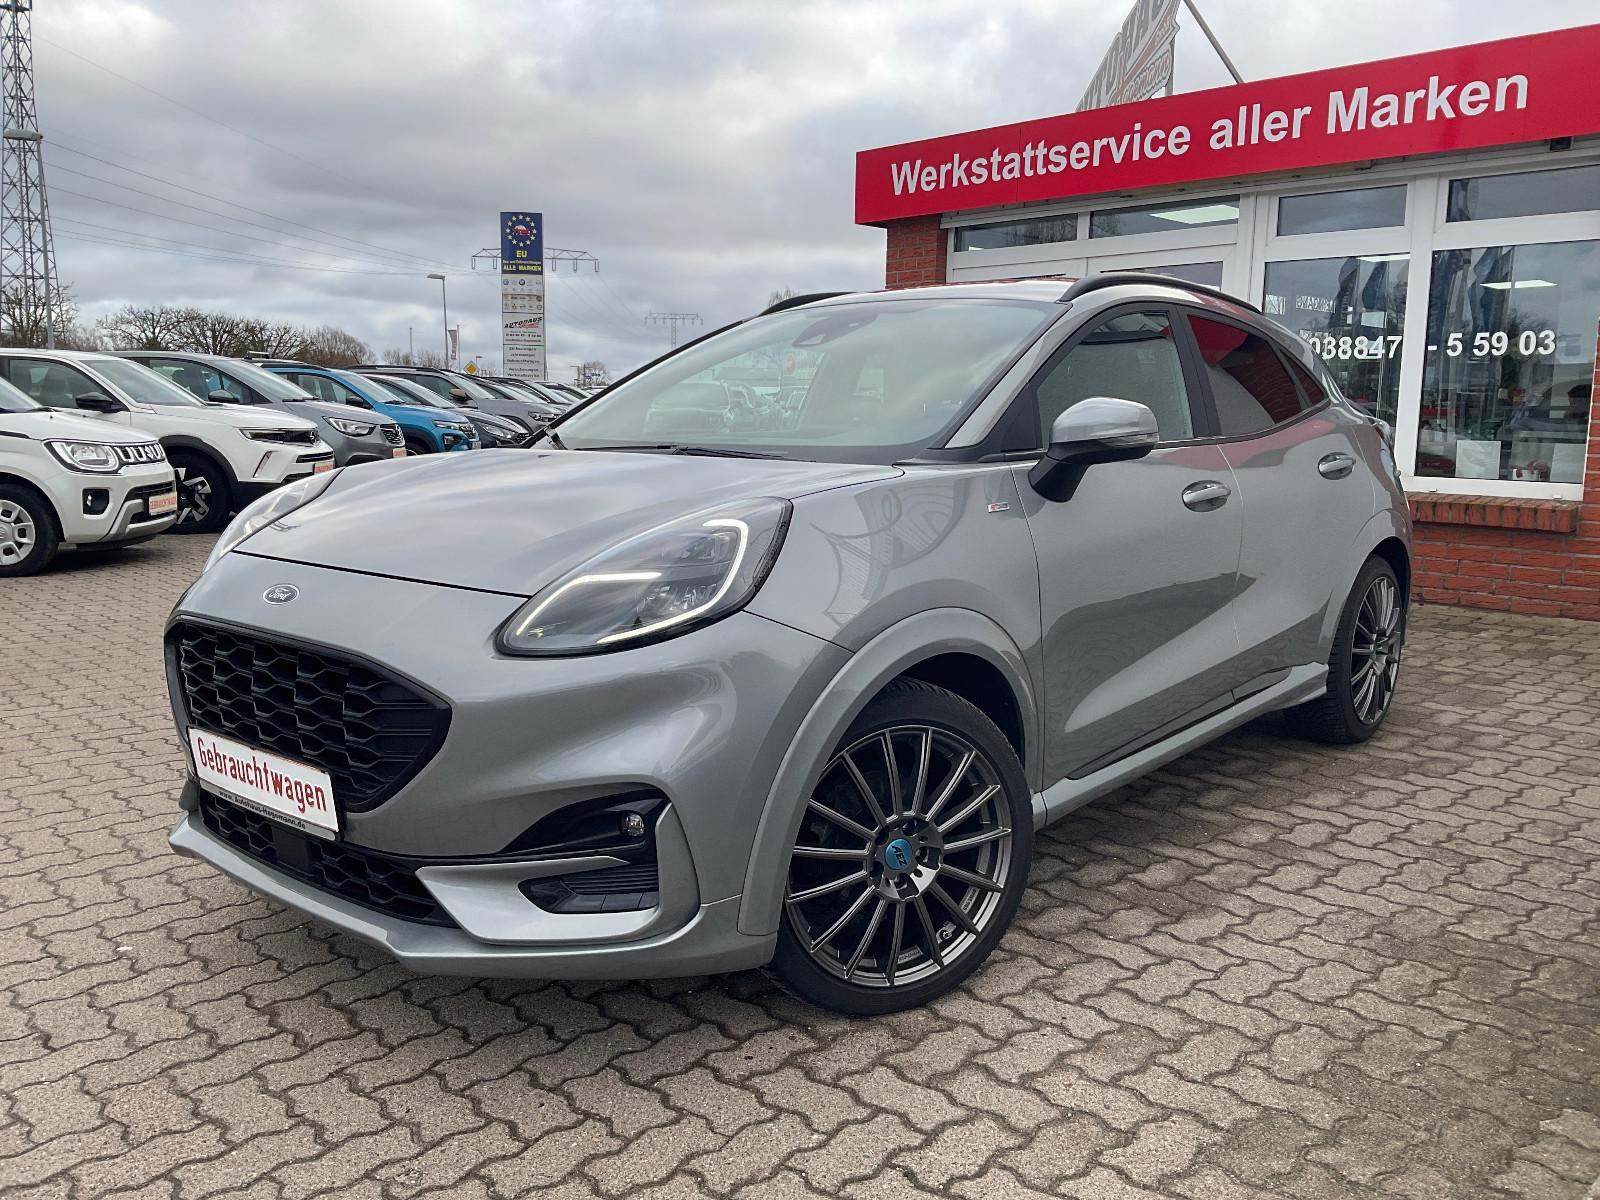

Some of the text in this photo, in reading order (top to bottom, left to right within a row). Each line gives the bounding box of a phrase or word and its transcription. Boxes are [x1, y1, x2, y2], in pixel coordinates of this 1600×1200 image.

[891, 73, 1529, 196] Werkstattservice aller Marken
[516, 250, 528, 258] EU
[504, 316, 543, 329] AUTOHAUS
[1446, 332, 1463, 357] 5
[1473, 331, 1508, 356] 59
[1519, 330, 1556, 355] 03
[196, 735, 327, 814] Gebrauchtwagen
